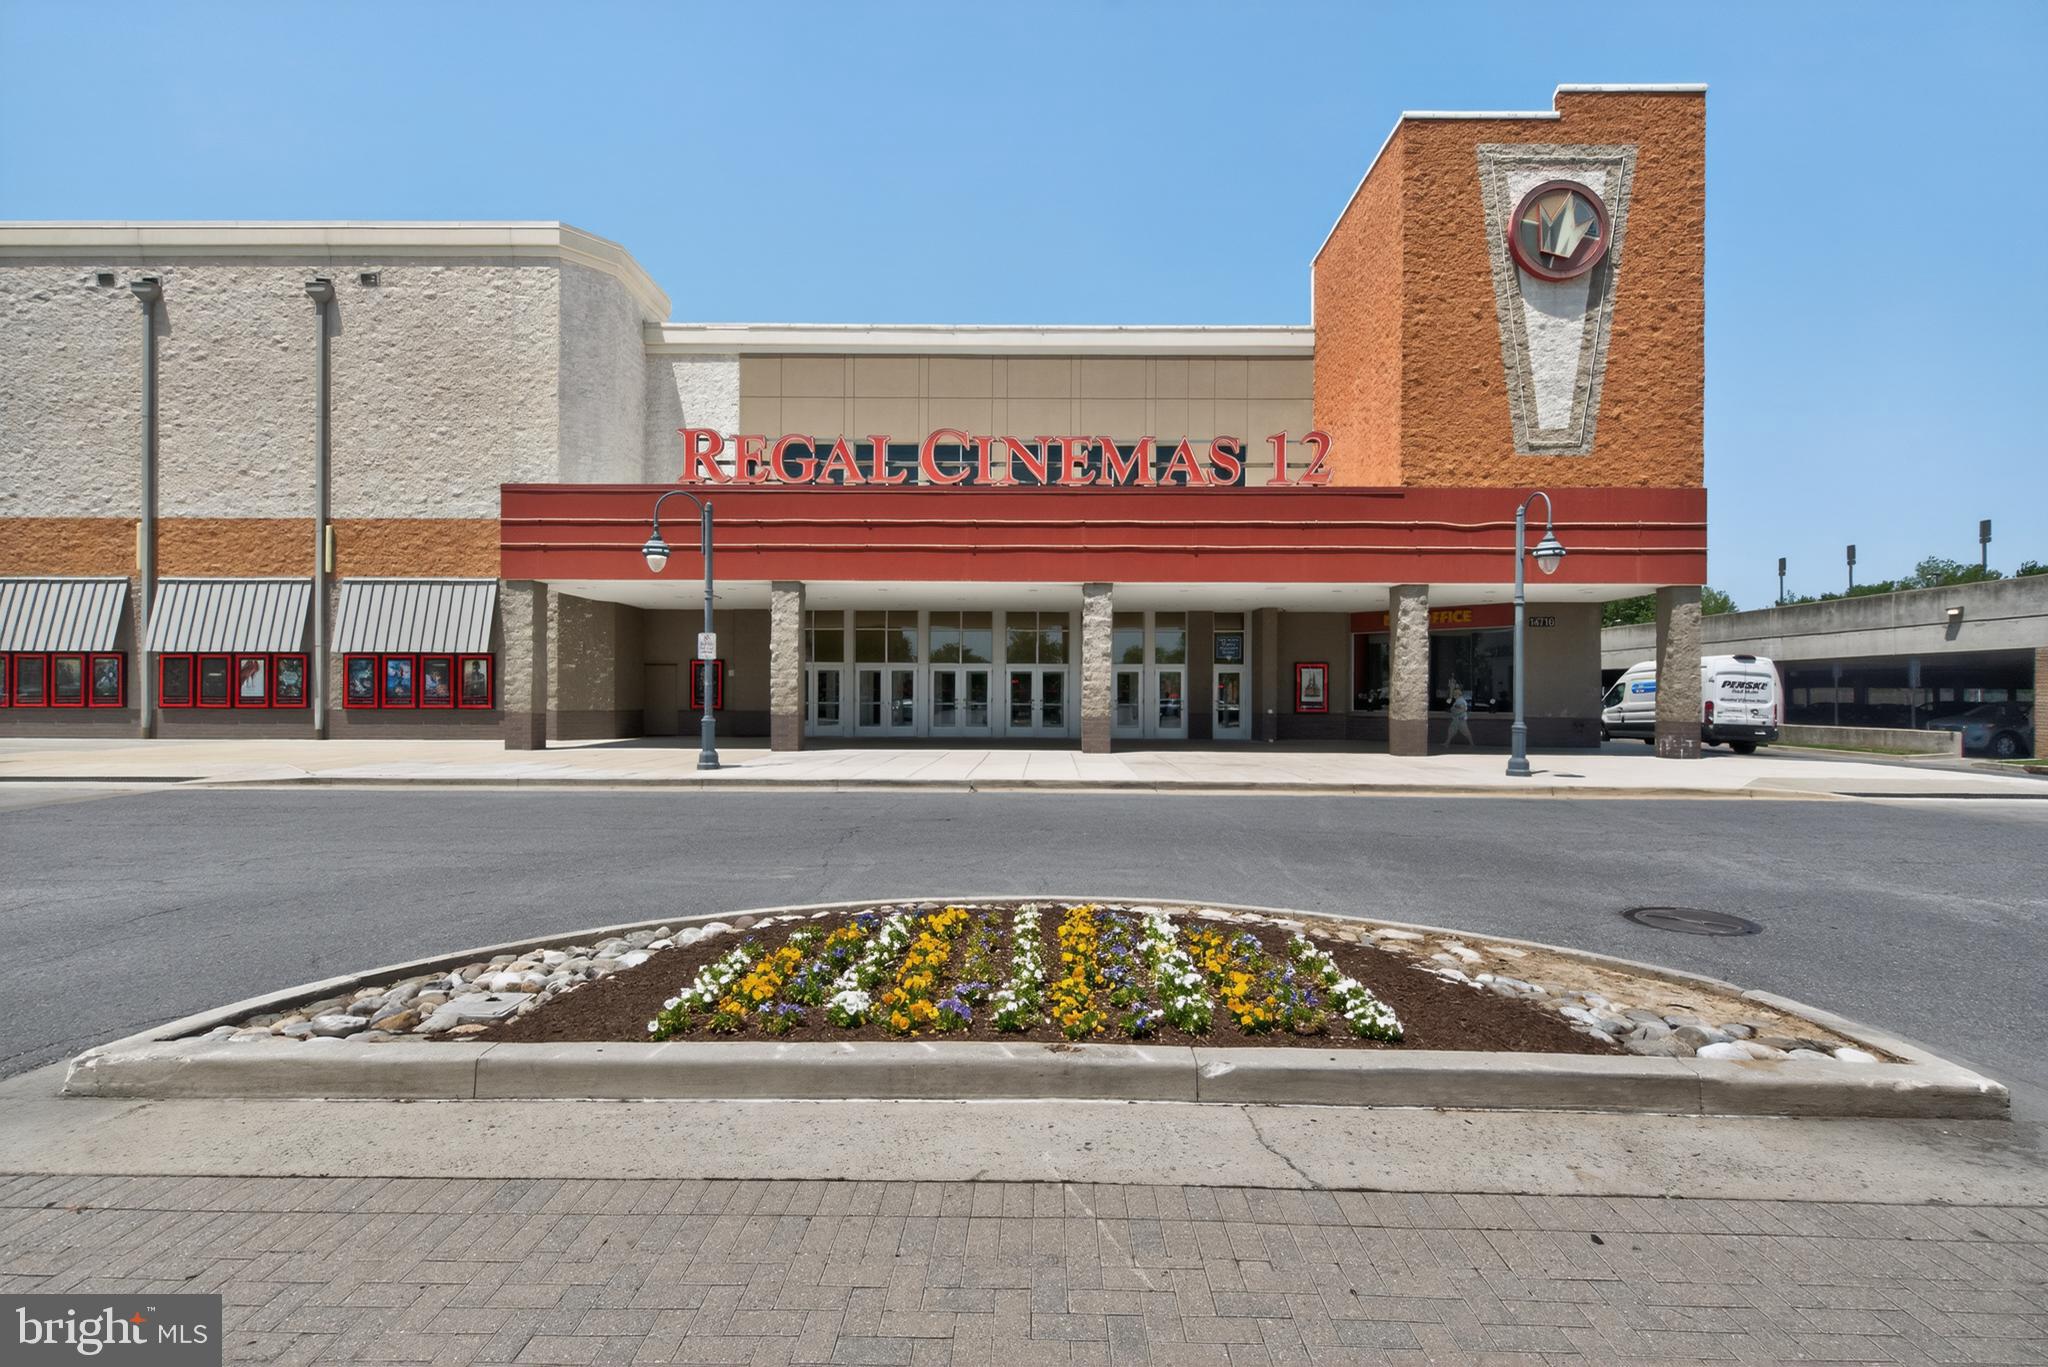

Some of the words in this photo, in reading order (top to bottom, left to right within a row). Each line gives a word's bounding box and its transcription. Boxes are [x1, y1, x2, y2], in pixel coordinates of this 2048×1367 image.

[677, 428, 908, 485] REGAL
[918, 427, 1242, 486] CINEMAS
[1266, 430, 1333, 486] 12
[1430, 609, 1473, 624] FFICE
[1721, 680, 1768, 691] PENSKE
